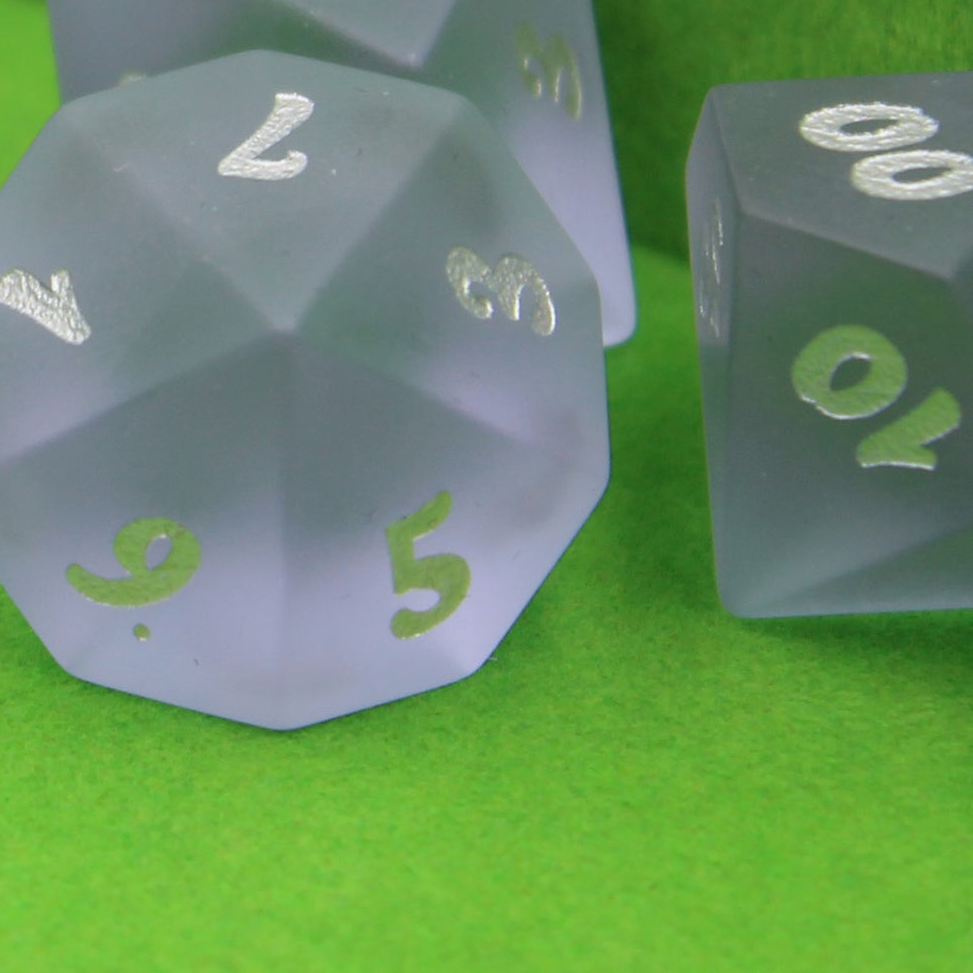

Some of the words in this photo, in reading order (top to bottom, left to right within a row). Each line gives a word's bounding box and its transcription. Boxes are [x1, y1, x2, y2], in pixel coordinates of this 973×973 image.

[217, 92, 315, 181] 7
[799, 101, 973, 201] 00
[445, 246, 556, 336] 3
[384, 490, 471, 640] 5
